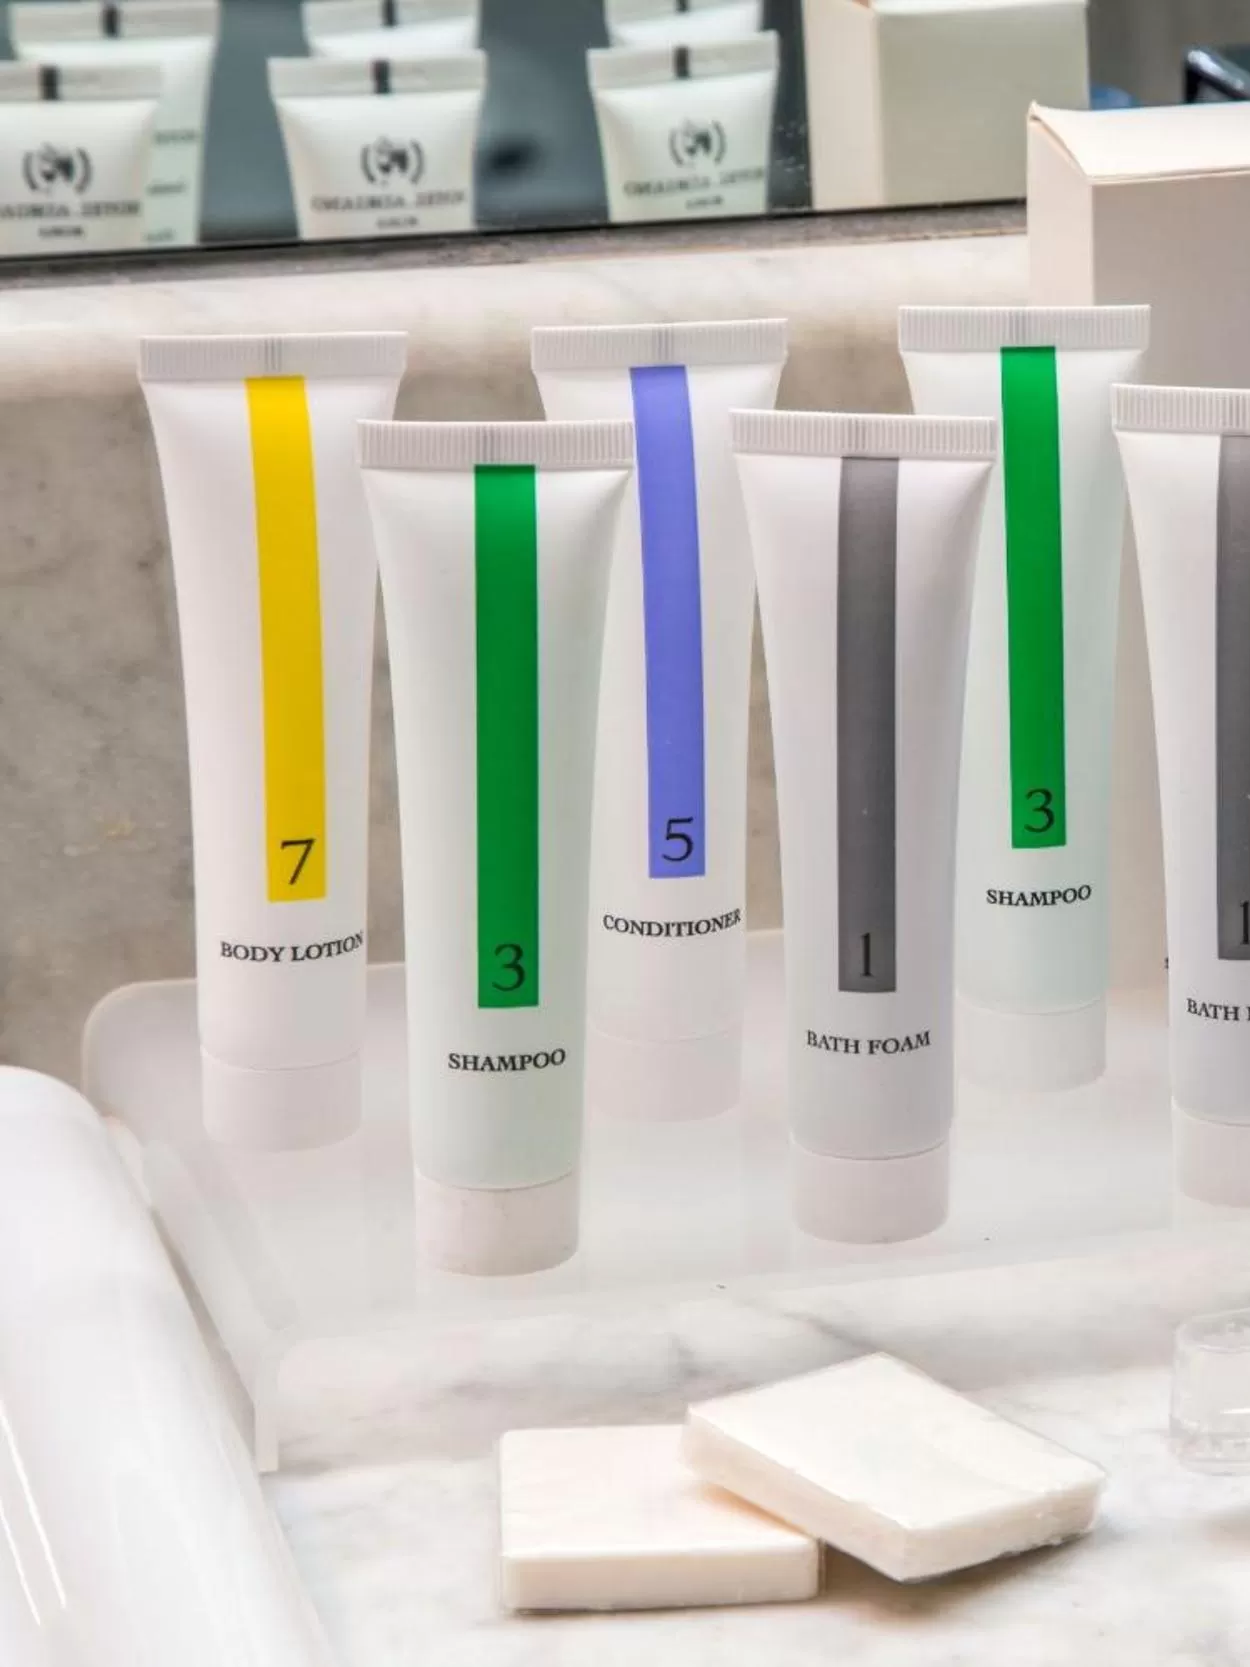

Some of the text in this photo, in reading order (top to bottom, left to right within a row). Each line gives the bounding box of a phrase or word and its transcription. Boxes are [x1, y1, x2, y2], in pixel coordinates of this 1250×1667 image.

[1024, 788, 1056, 833] 3
[662, 816, 695, 862] 5
[280, 838, 316, 886] 7
[985, 884, 1093, 907] SHAMPOO
[602, 907, 742, 938] CONDITIONER
[1239, 901, 1250, 945] 1
[219, 930, 363, 964] BODY LOTION
[861, 932, 874, 977] 1
[491, 943, 527, 993] 3
[1186, 997, 1241, 1022] BATH
[447, 1047, 567, 1073] SHAMPOO
[805, 1030, 932, 1056] BATH FOAM
